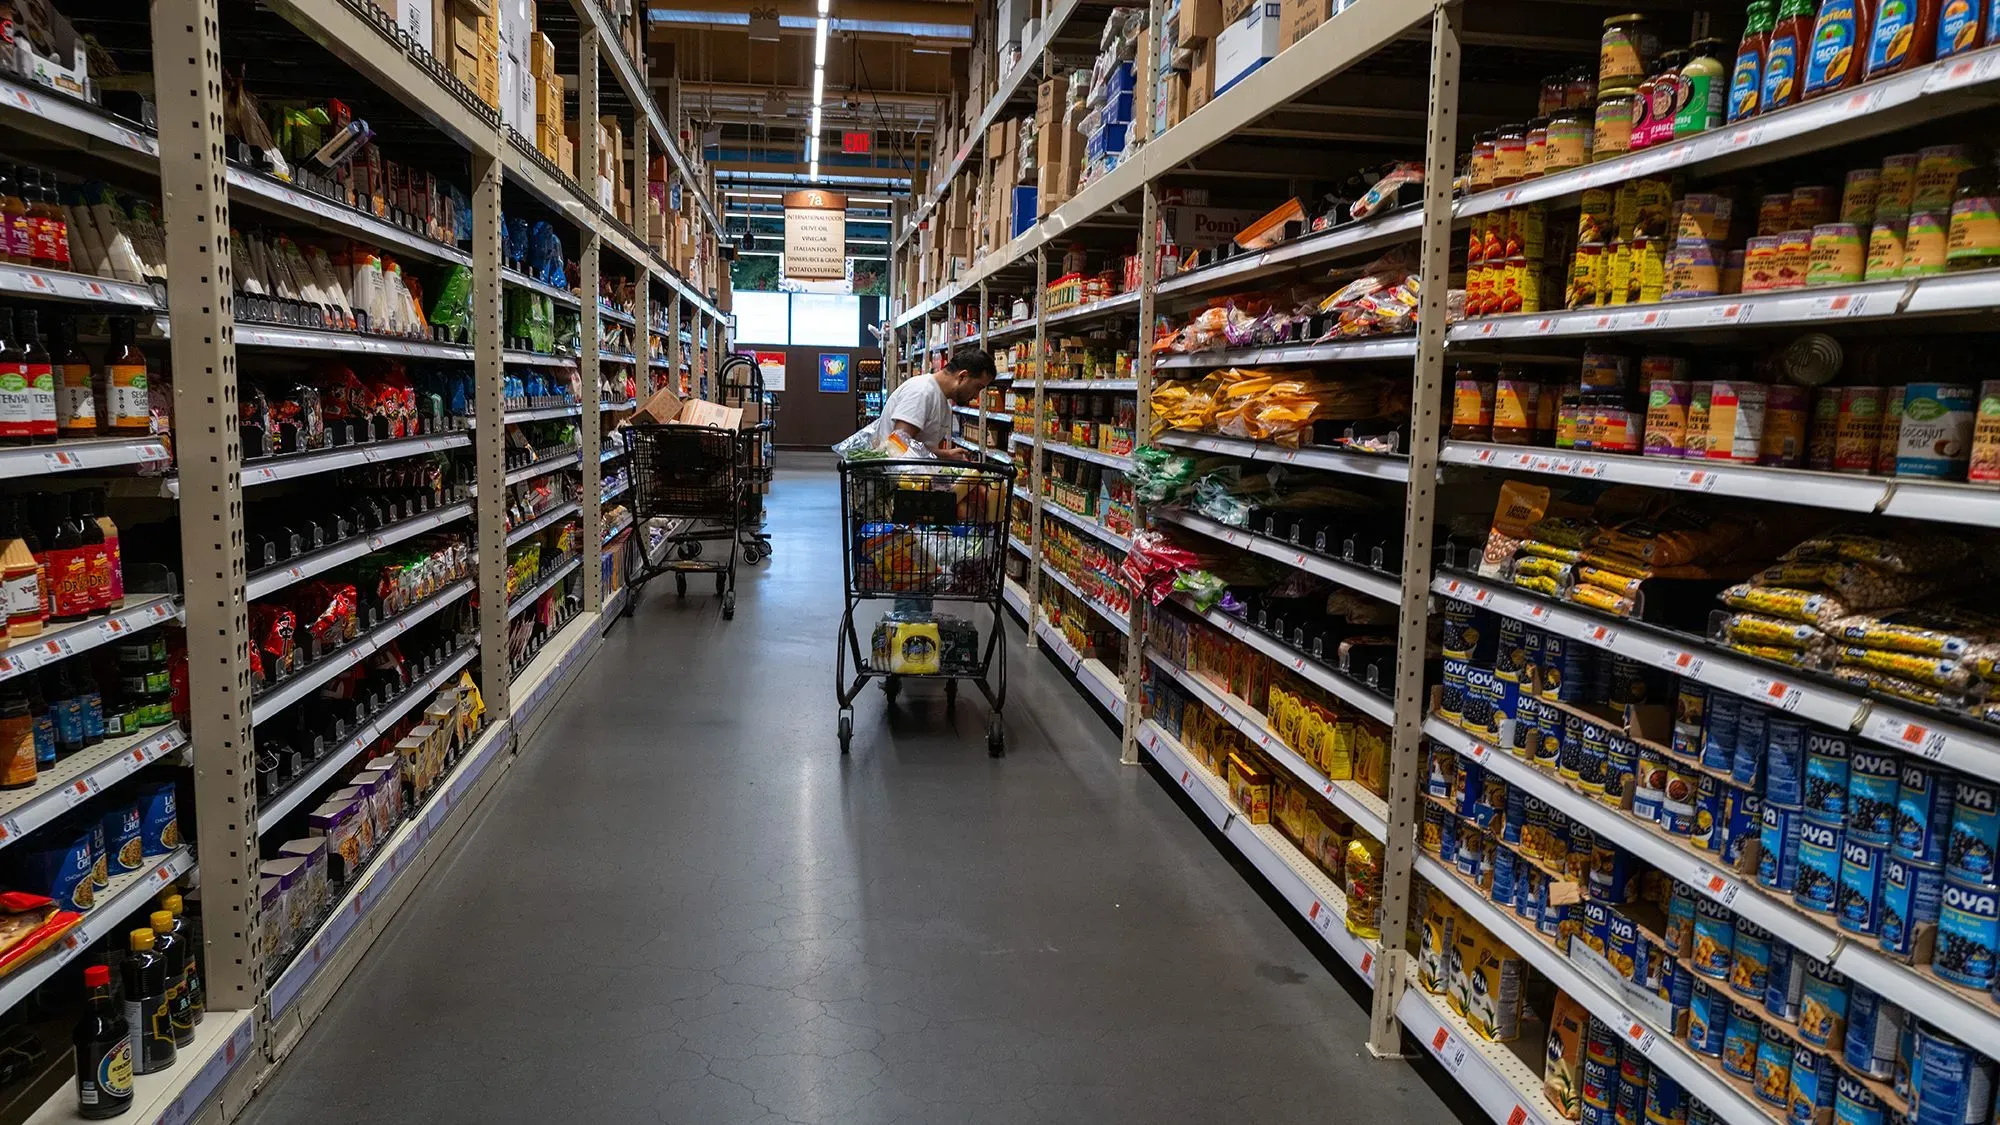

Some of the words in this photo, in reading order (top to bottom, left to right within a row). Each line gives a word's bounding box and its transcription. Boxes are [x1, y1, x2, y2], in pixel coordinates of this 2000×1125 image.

[845, 133, 870, 152] EXIT
[807, 192, 824, 206] 7a
[1902, 426, 1946, 440] COCONUT
[1907, 438, 1930, 449] MILK
[1501, 617, 1523, 633] OYA
[1525, 632, 1539, 646] YA
[1546, 639, 1560, 652] YA
[1467, 670, 1494, 686] GOY
[1491, 680, 1504, 695] YA
[1517, 696, 1539, 711] OYA
[1539, 706, 1559, 721] YA
[1565, 712, 1581, 728] GO
[1584, 724, 1608, 742] OY
[1609, 737, 1637, 755] OYA
[1809, 736, 1847, 757] OYA
[1901, 765, 1924, 788] YA
[1524, 796, 1548, 812] GOY
[1548, 808, 1566, 823] YA
[123, 820, 140, 832] CHO
[1570, 822, 1587, 837] GO
[1801, 823, 1834, 846] OYA
[1844, 842, 1867, 865] YA
[1584, 905, 1604, 922] YA
[1697, 899, 1731, 919] OYA
[1737, 918, 1772, 939] OYA
[1807, 959, 1843, 983] OYA
[1795, 1045, 1813, 1067] YA
[1585, 1058, 1606, 1076] OYA
[1838, 1076, 1876, 1105] OYA
[1582, 1102, 1597, 1118] YA
